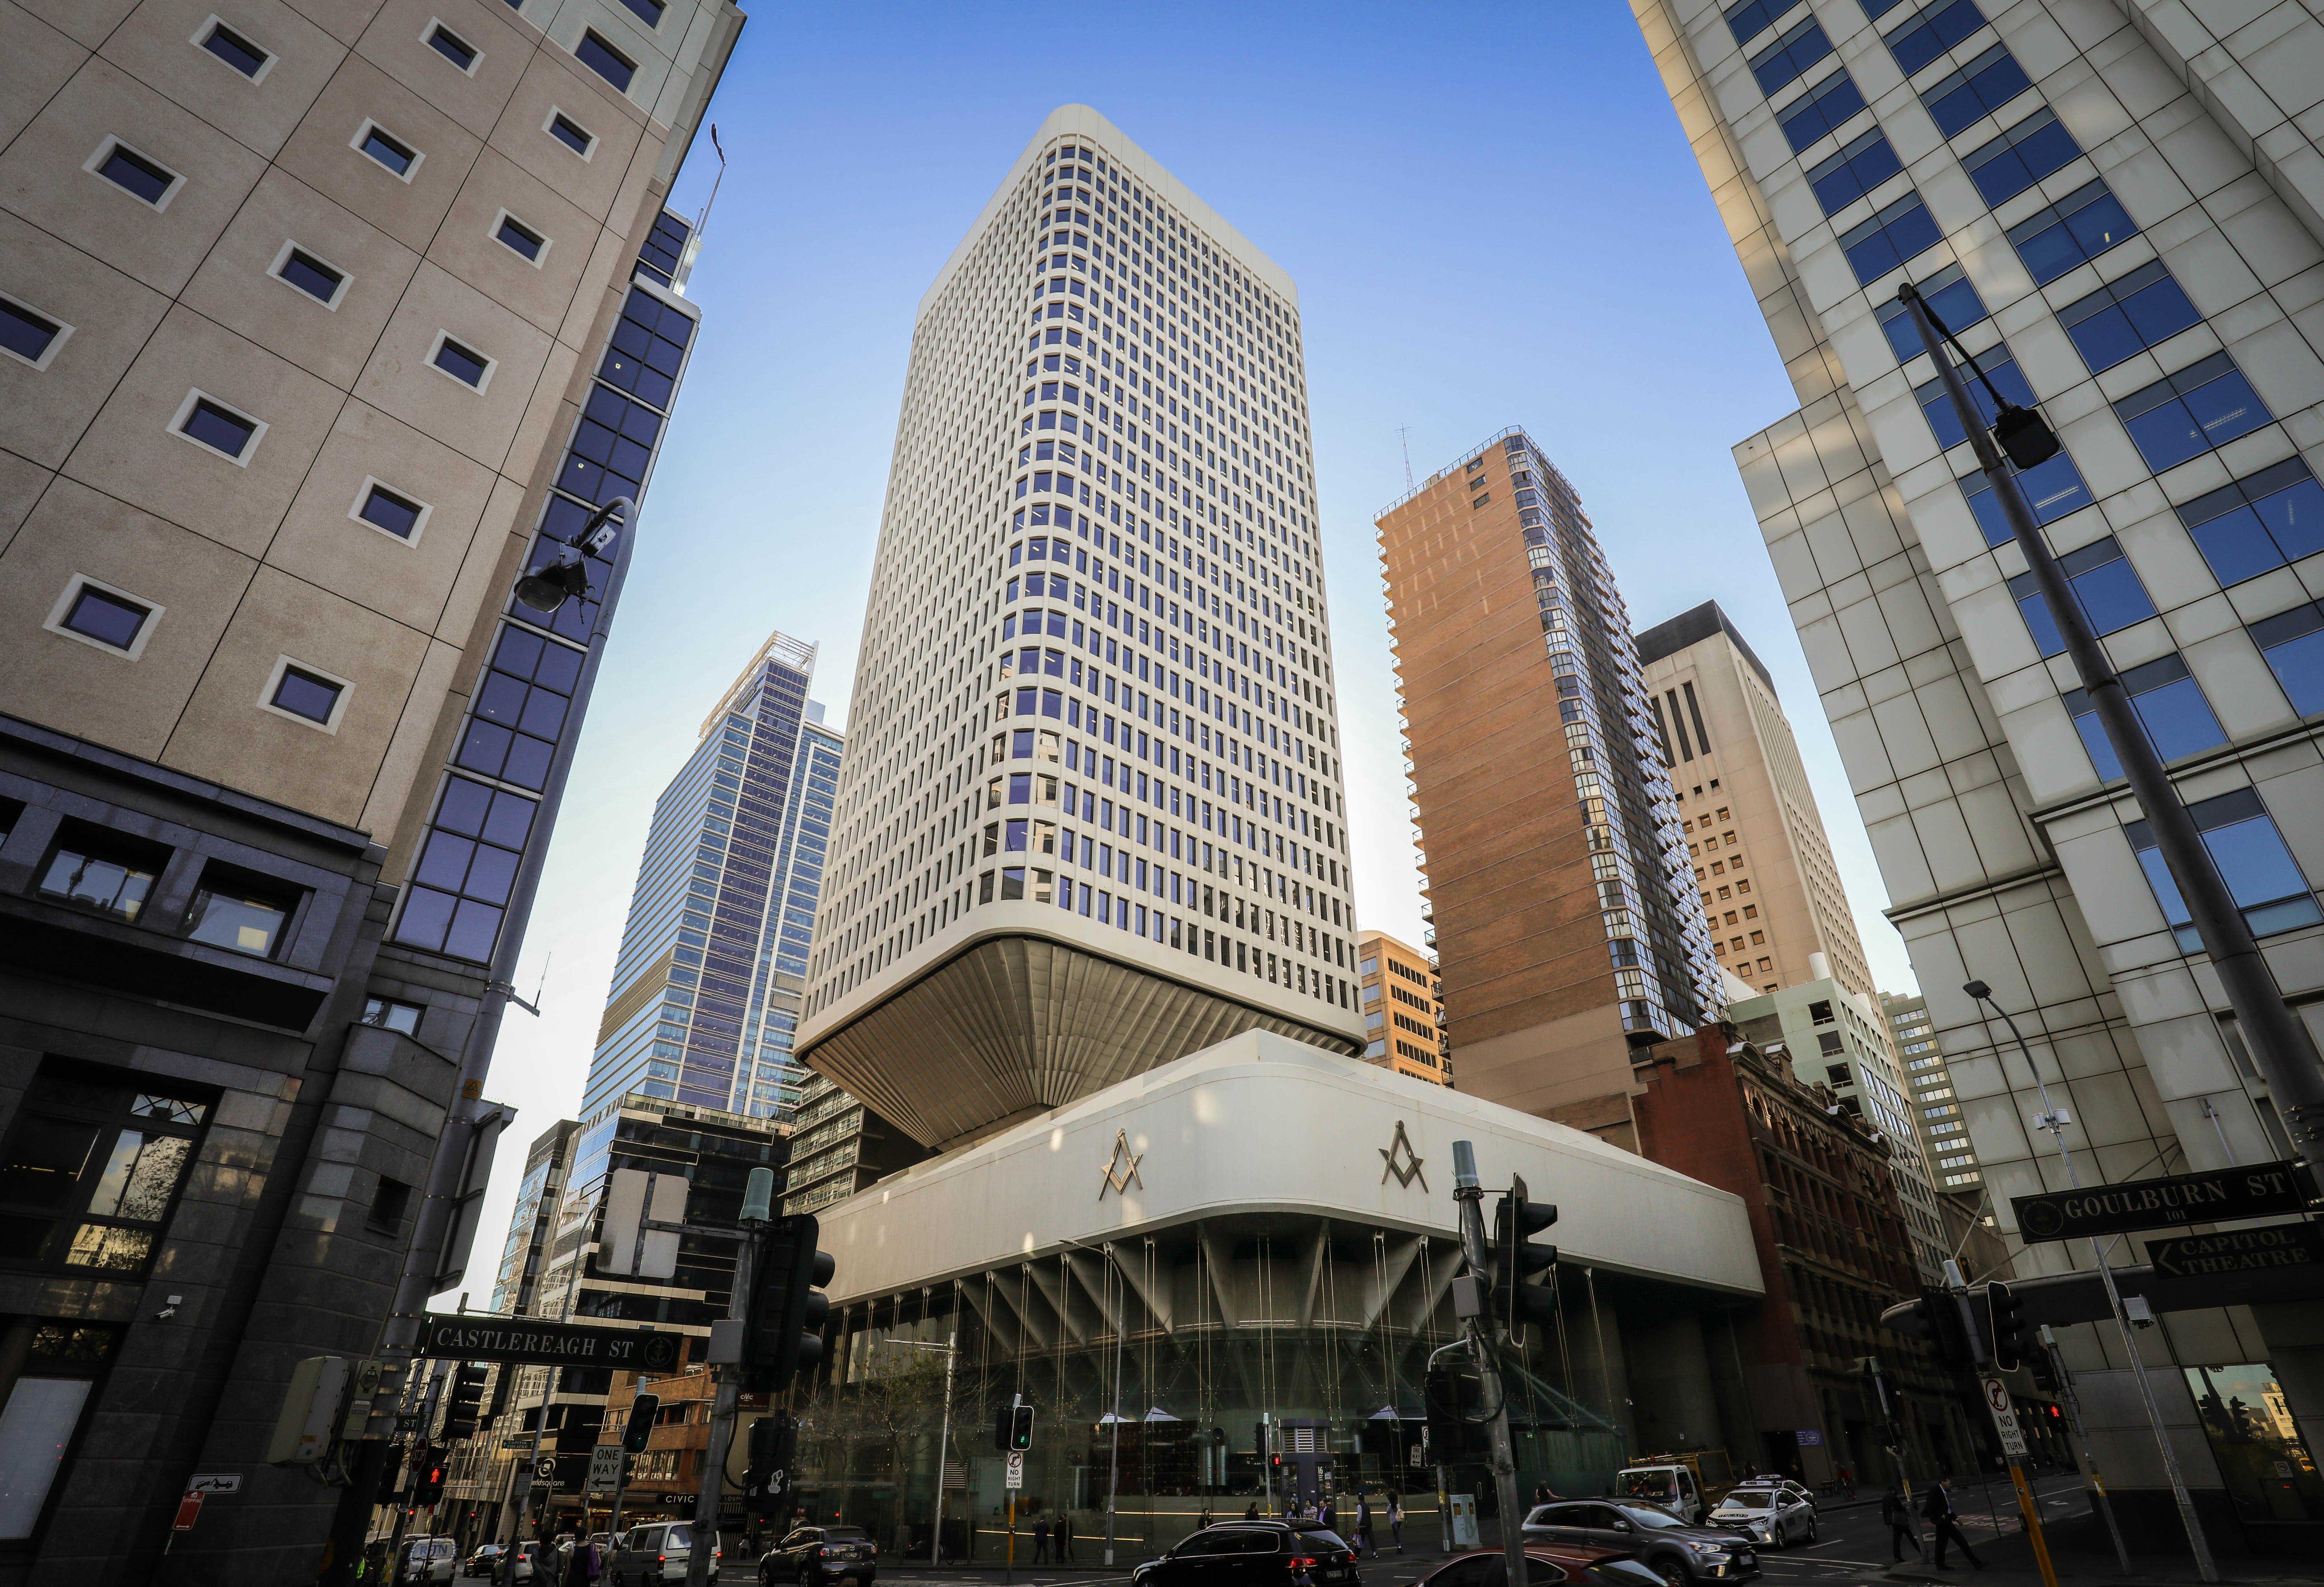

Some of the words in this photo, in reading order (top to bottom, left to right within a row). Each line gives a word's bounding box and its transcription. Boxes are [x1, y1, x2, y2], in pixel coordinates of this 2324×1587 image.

[2065, 1180, 2227, 1218] GOULBURN
[2247, 1173, 2286, 1196] ST
[2166, 1210, 2187, 1222] 101
[2180, 1230, 2296, 1255] CAPITOL
[2181, 1247, 2310, 1275] THEATRE
[437, 1328, 597, 1355] CASTLEREAGH
[609, 1340, 633, 1358] ST
[403, 1419, 417, 1428] ST
[1999, 1416, 2012, 1427] NO
[2001, 1430, 2019, 1439] RIGHT
[2005, 1441, 2023, 1450] TURN
[413, 1449, 426, 1461] STOP
[597, 1449, 619, 1460] ONE
[593, 1464, 618, 1474] WAY
